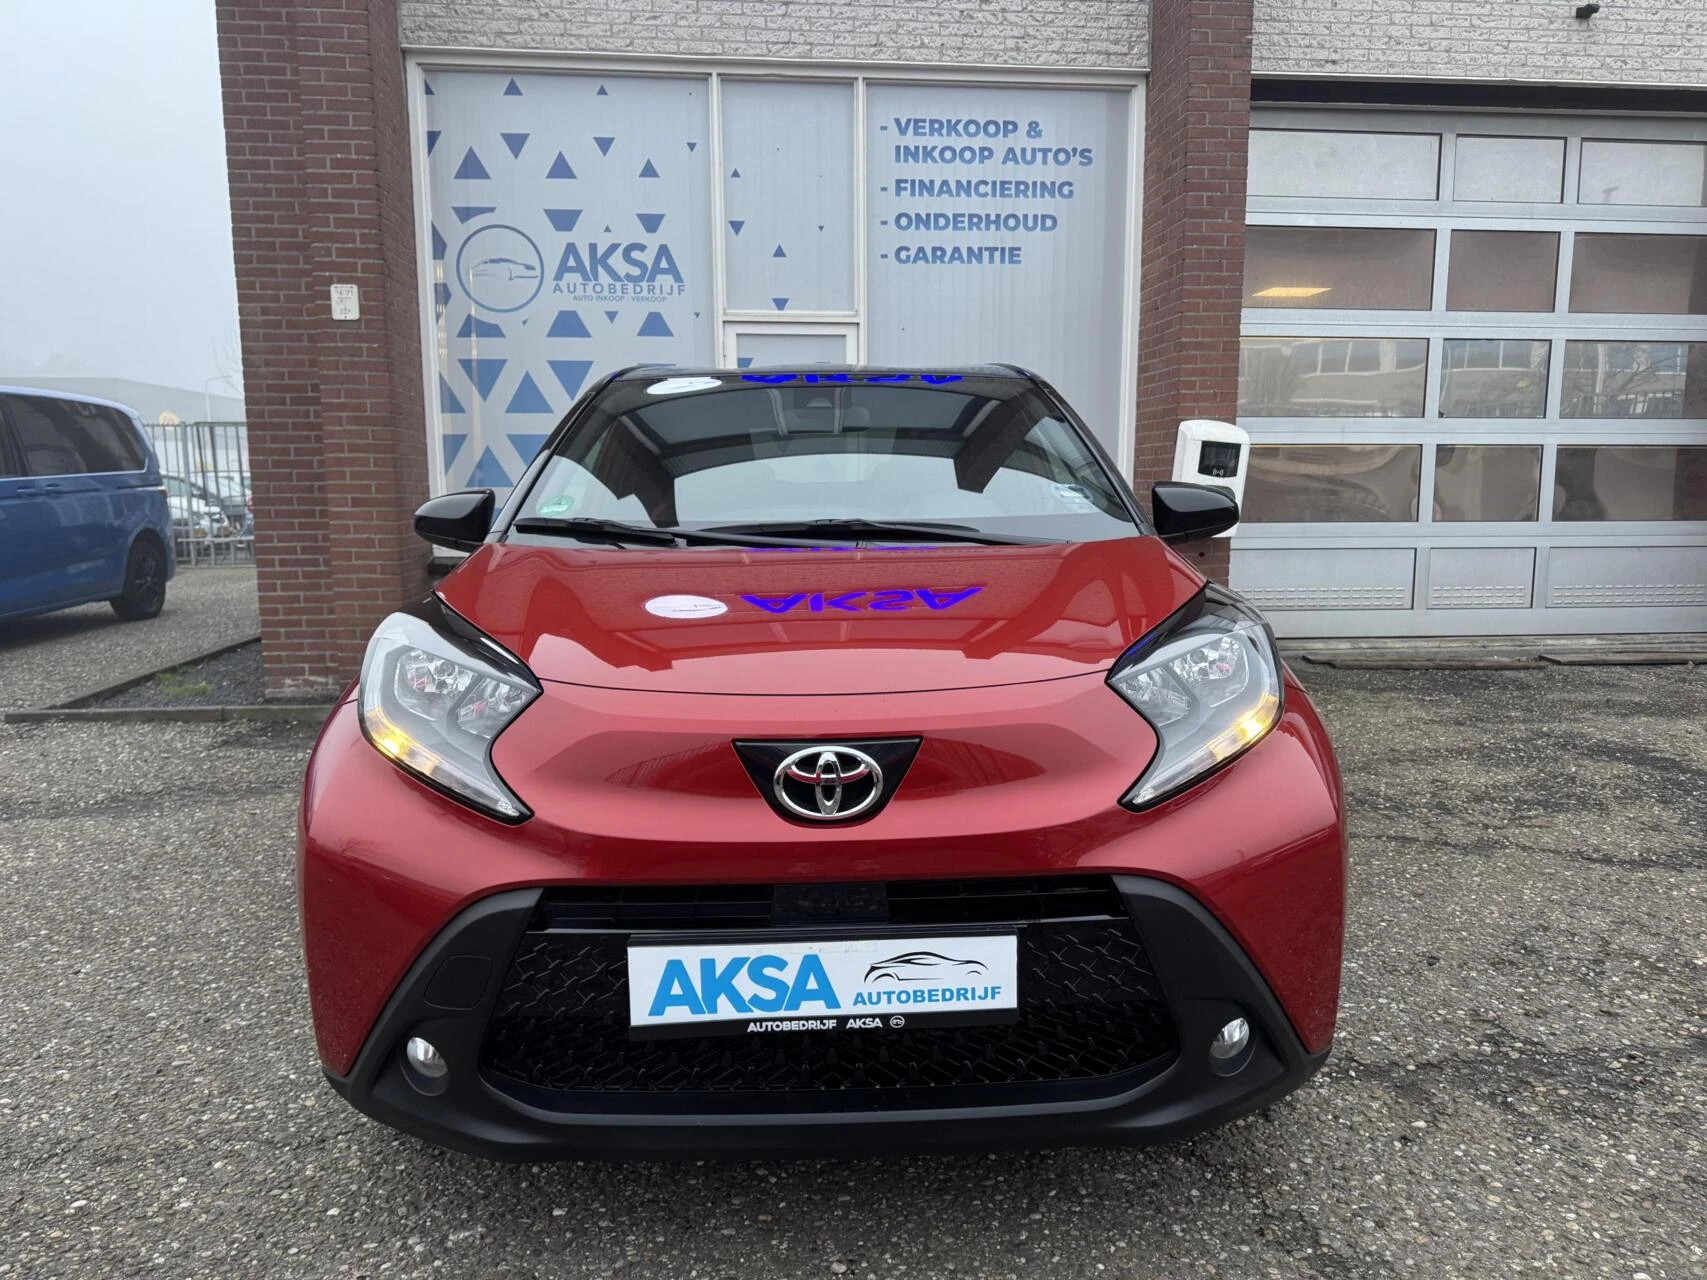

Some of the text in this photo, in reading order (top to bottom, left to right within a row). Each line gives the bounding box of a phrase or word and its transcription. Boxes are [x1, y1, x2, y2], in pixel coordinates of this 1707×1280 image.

[894, 117, 1019, 139] VERKOOP
[1025, 120, 1044, 139] &
[894, 145, 1093, 167] INKOOP AUTO'S
[894, 178, 1075, 199] FINANCIERING
[894, 212, 1058, 232] ONDERHOUD
[552, 242, 685, 284] AKSA
[894, 246, 1022, 265] GARANTIE
[552, 282, 686, 296] AUTOBEDRIJF
[572, 294, 594, 302] AUTO
[595, 294, 626, 302] INKOOP
[631, 295, 668, 303] VERKOOP
[648, 953, 1002, 1017] AKSA AUTOBEDRIJF
[747, 1017, 883, 1033] AUTOBEDRIJF AKSA
